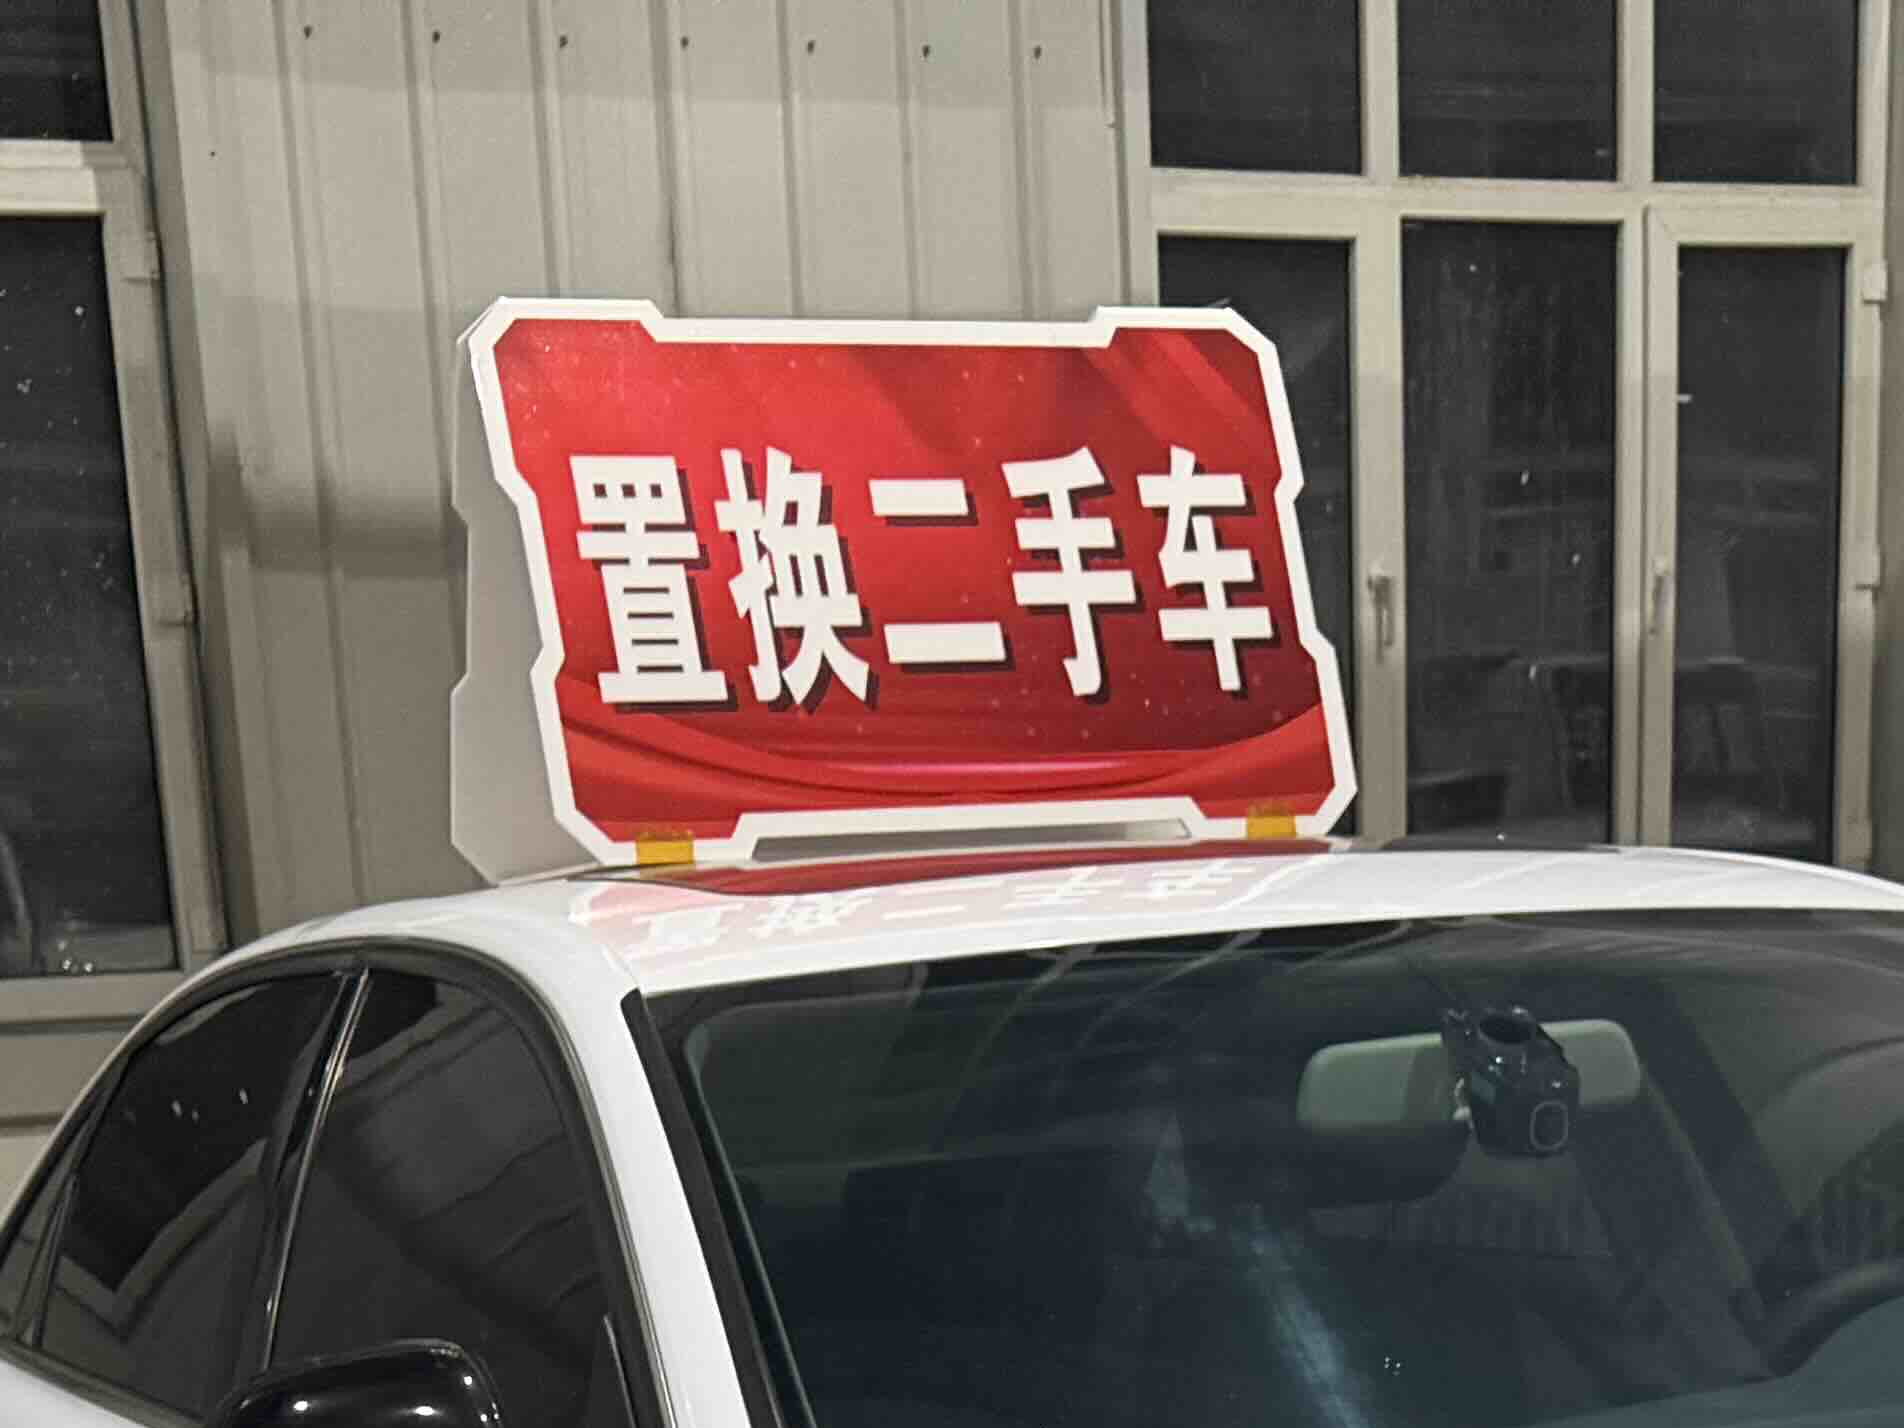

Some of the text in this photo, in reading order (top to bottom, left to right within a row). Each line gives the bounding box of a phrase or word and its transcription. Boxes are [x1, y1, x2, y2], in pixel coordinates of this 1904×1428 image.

[568, 446, 1273, 705] 置换二手车
